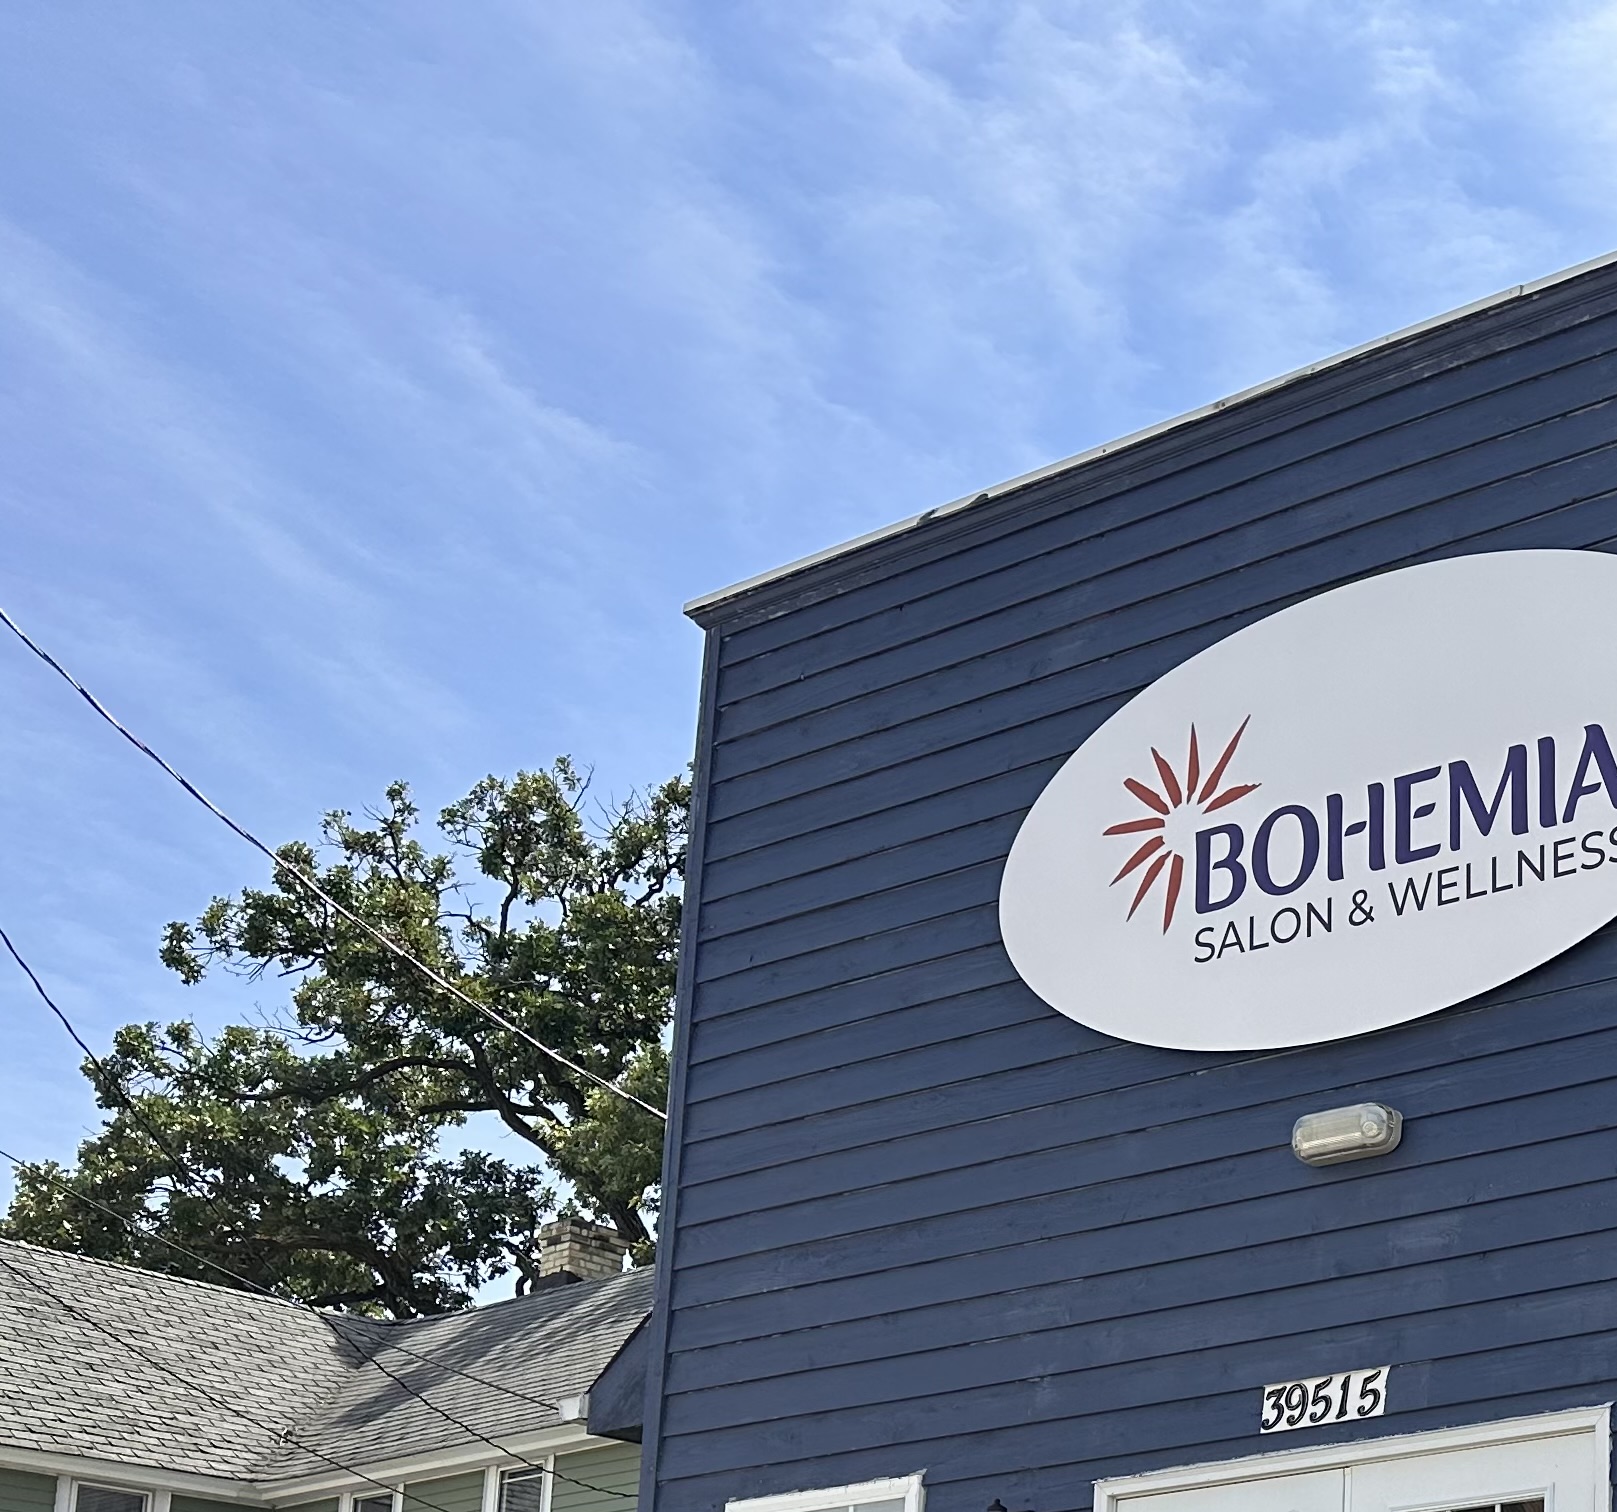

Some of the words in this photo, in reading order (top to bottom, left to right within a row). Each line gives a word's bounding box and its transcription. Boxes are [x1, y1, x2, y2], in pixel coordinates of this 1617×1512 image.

[1194, 897, 1333, 963] SALON
[1348, 889, 1375, 926] &
[1262, 1370, 1381, 1430] 39515
